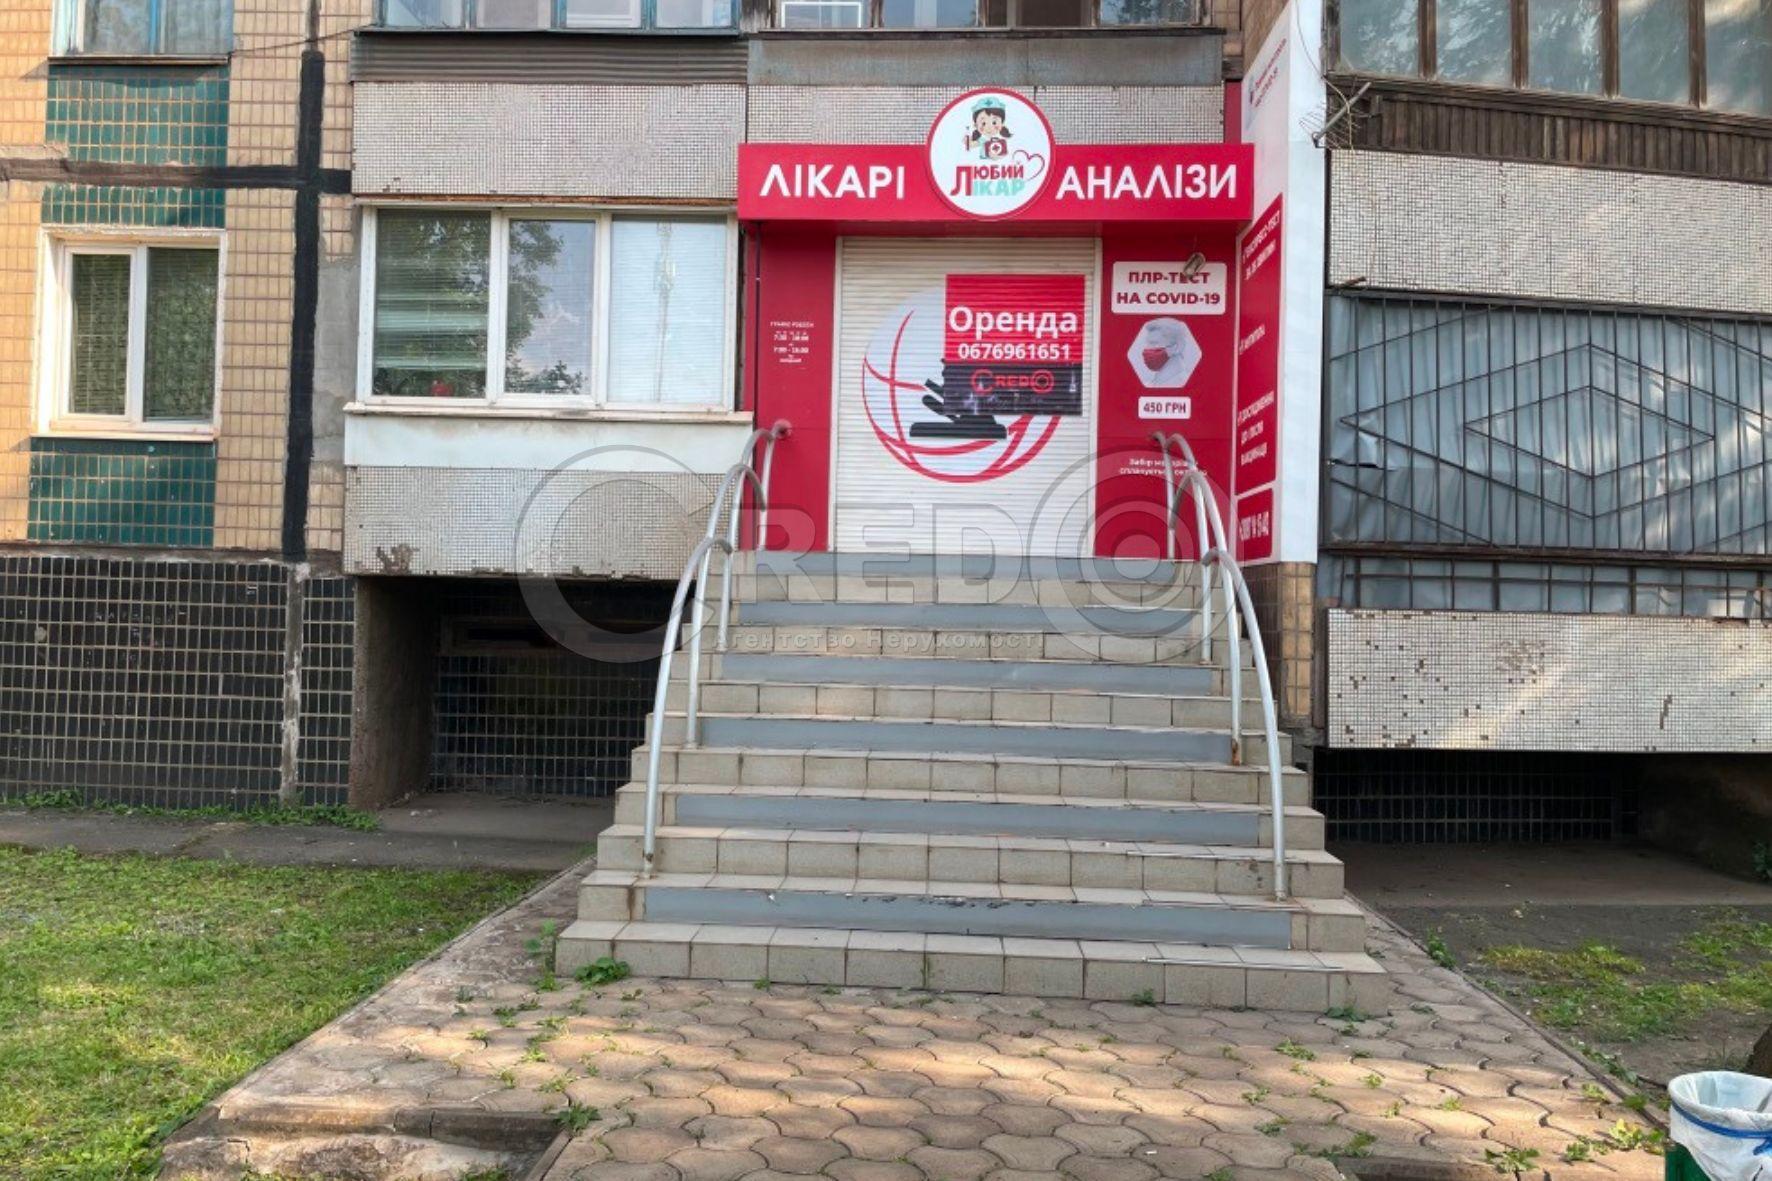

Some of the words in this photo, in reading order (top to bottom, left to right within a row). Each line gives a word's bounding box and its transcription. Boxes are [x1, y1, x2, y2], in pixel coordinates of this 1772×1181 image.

[759, 164, 905, 199] ЛІКАРІ
[1055, 163, 1238, 200] АНАЛІЗИ
[1116, 292, 1143, 305] НА
[1145, 292, 1221, 305] COVID-19
[949, 306, 1078, 339] Оренда
[957, 342, 1071, 360] 0676961651
[1143, 402, 1164, 414] 450
[1165, 402, 1187, 414] ГРН
